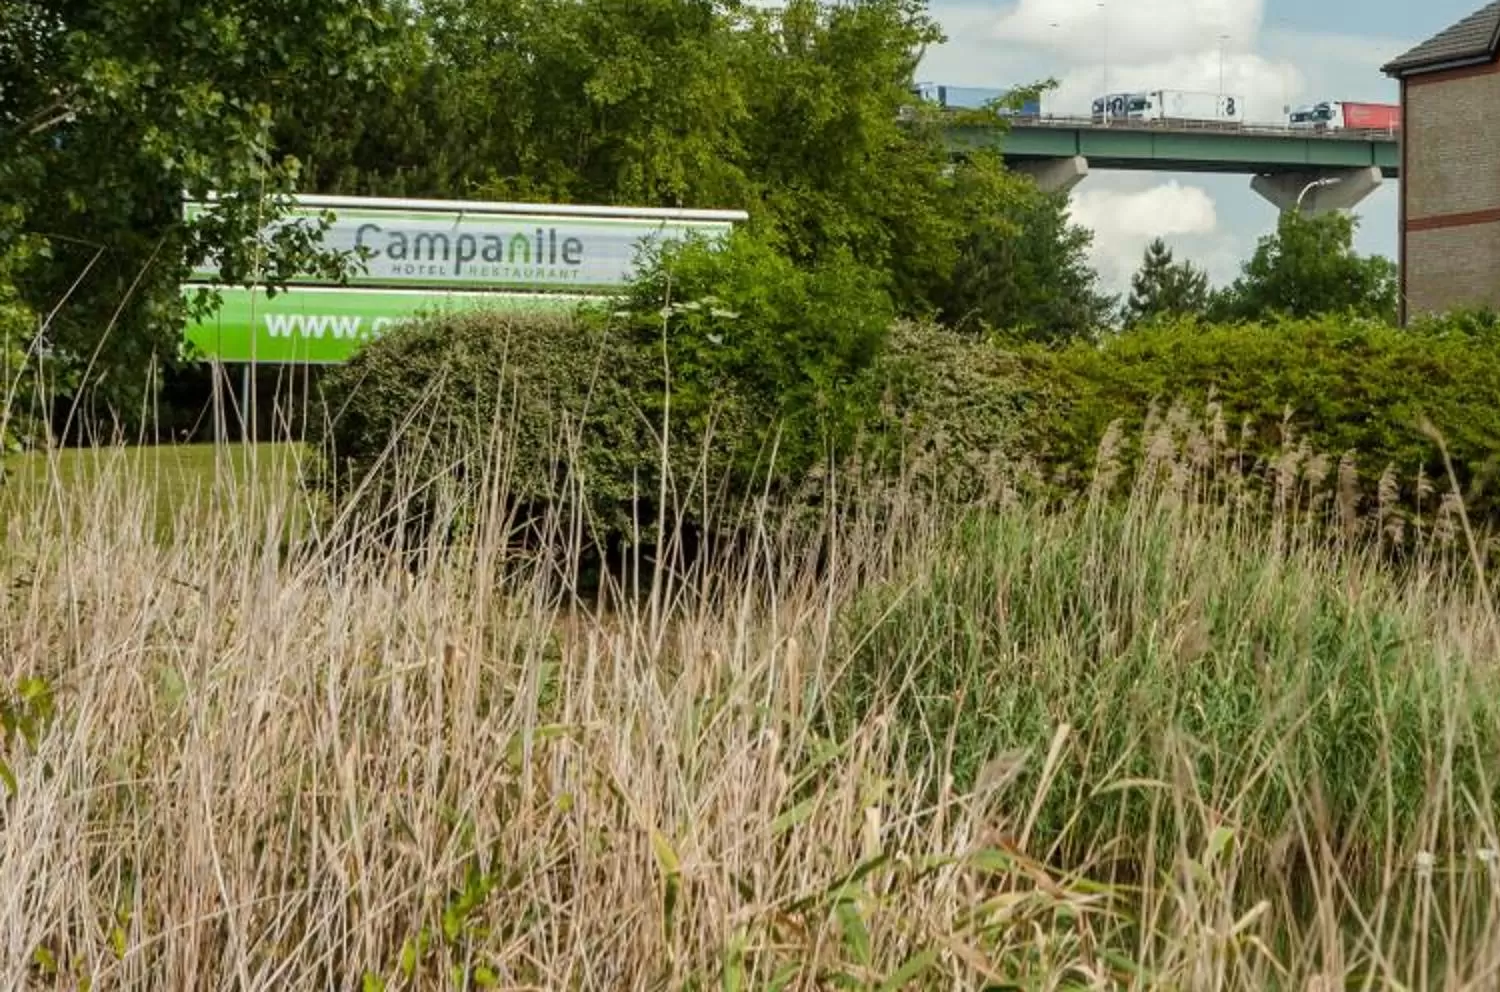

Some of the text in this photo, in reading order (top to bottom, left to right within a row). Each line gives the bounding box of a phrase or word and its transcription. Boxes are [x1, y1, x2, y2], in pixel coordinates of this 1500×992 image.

[356, 223, 584, 275] Campanile
[392, 264, 579, 280] HOTEL RESTAURANT
